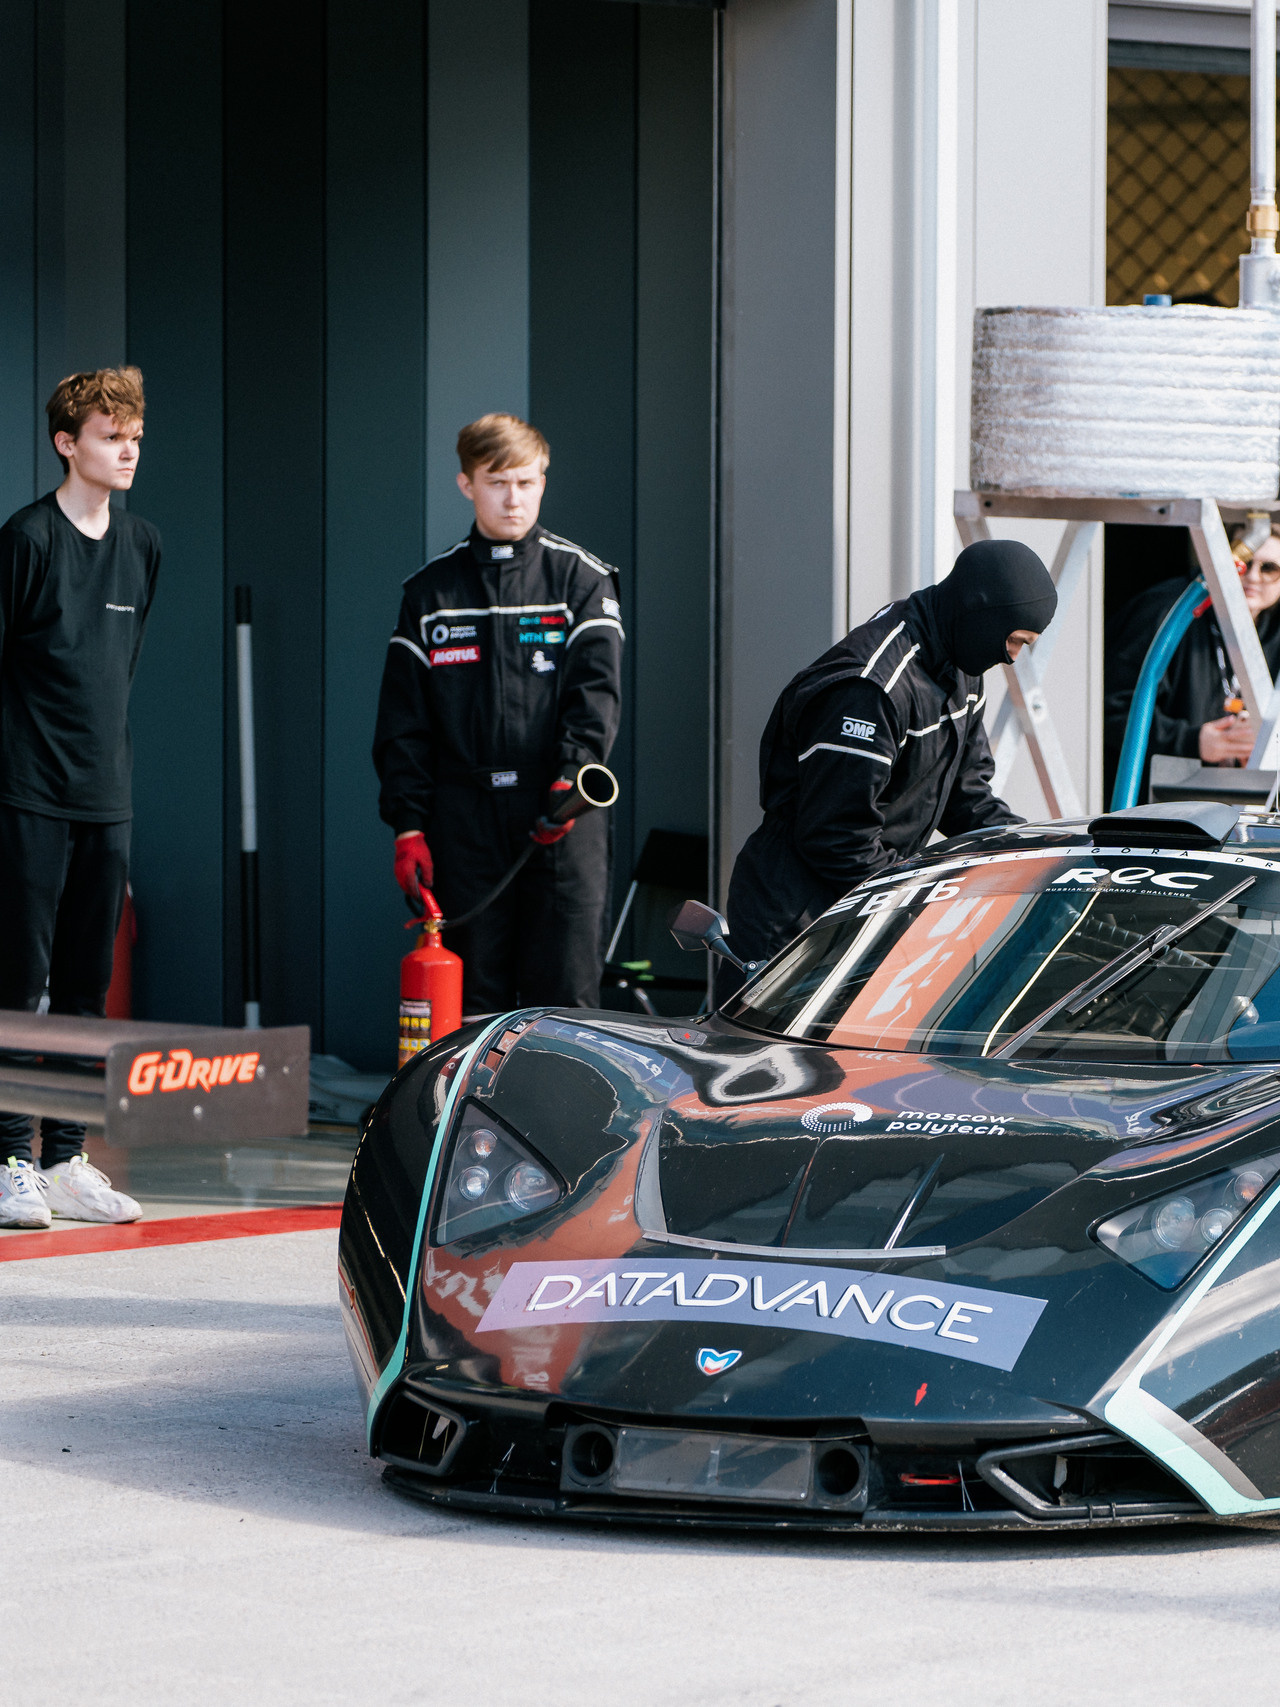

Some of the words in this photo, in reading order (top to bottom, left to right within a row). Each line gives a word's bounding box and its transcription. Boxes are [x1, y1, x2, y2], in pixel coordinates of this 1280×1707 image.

[433, 648, 479, 664] MOTUL
[842, 720, 876, 738] OMP
[857, 876, 967, 917] ВТБ
[1140, 889, 1192, 898] CHALLENGE
[897, 1110, 1015, 1124] moscow
[885, 1120, 1006, 1136] polytech
[526, 1271, 994, 1345] DATADVANCE
